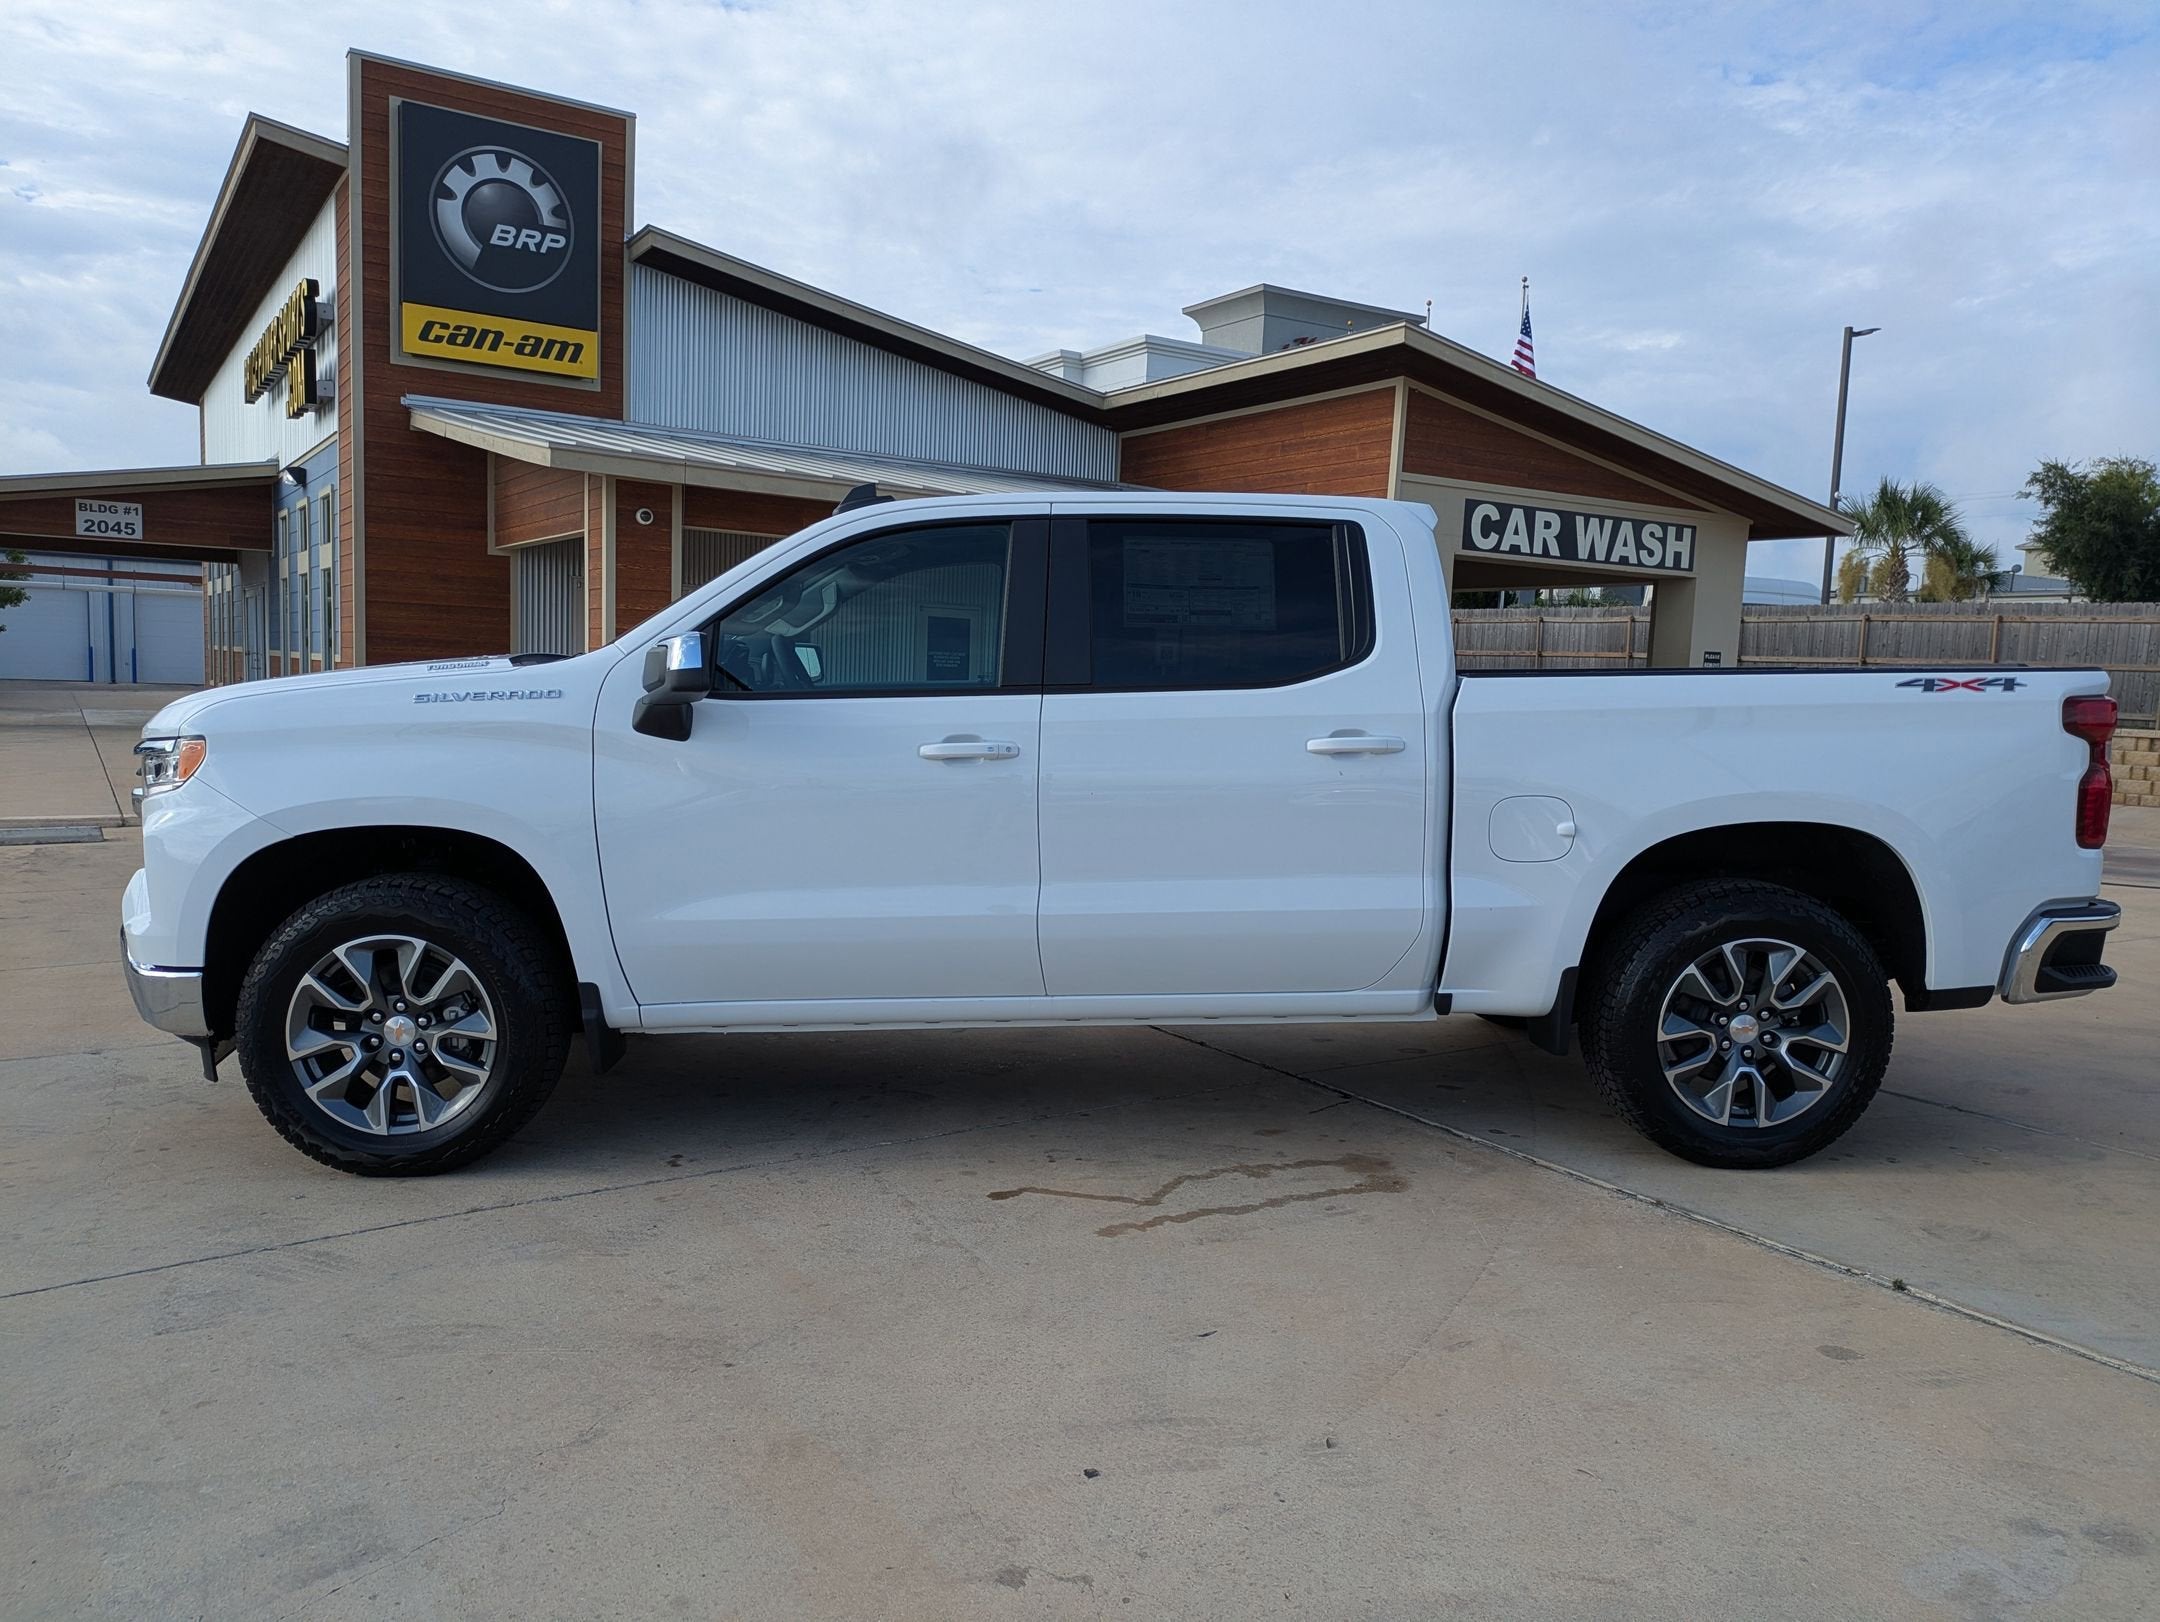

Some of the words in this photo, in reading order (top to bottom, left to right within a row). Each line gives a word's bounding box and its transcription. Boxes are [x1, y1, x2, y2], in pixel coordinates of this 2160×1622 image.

[490, 223, 566, 254] BRP
[418, 320, 584, 364] can-am
[78, 502, 119, 514] BLDG
[123, 505, 139, 516] #1
[83, 518, 137, 536] 2045
[1471, 503, 1561, 557] CAR
[1576, 515, 1692, 569] WASH
[413, 689, 563, 704] SILVERADO
